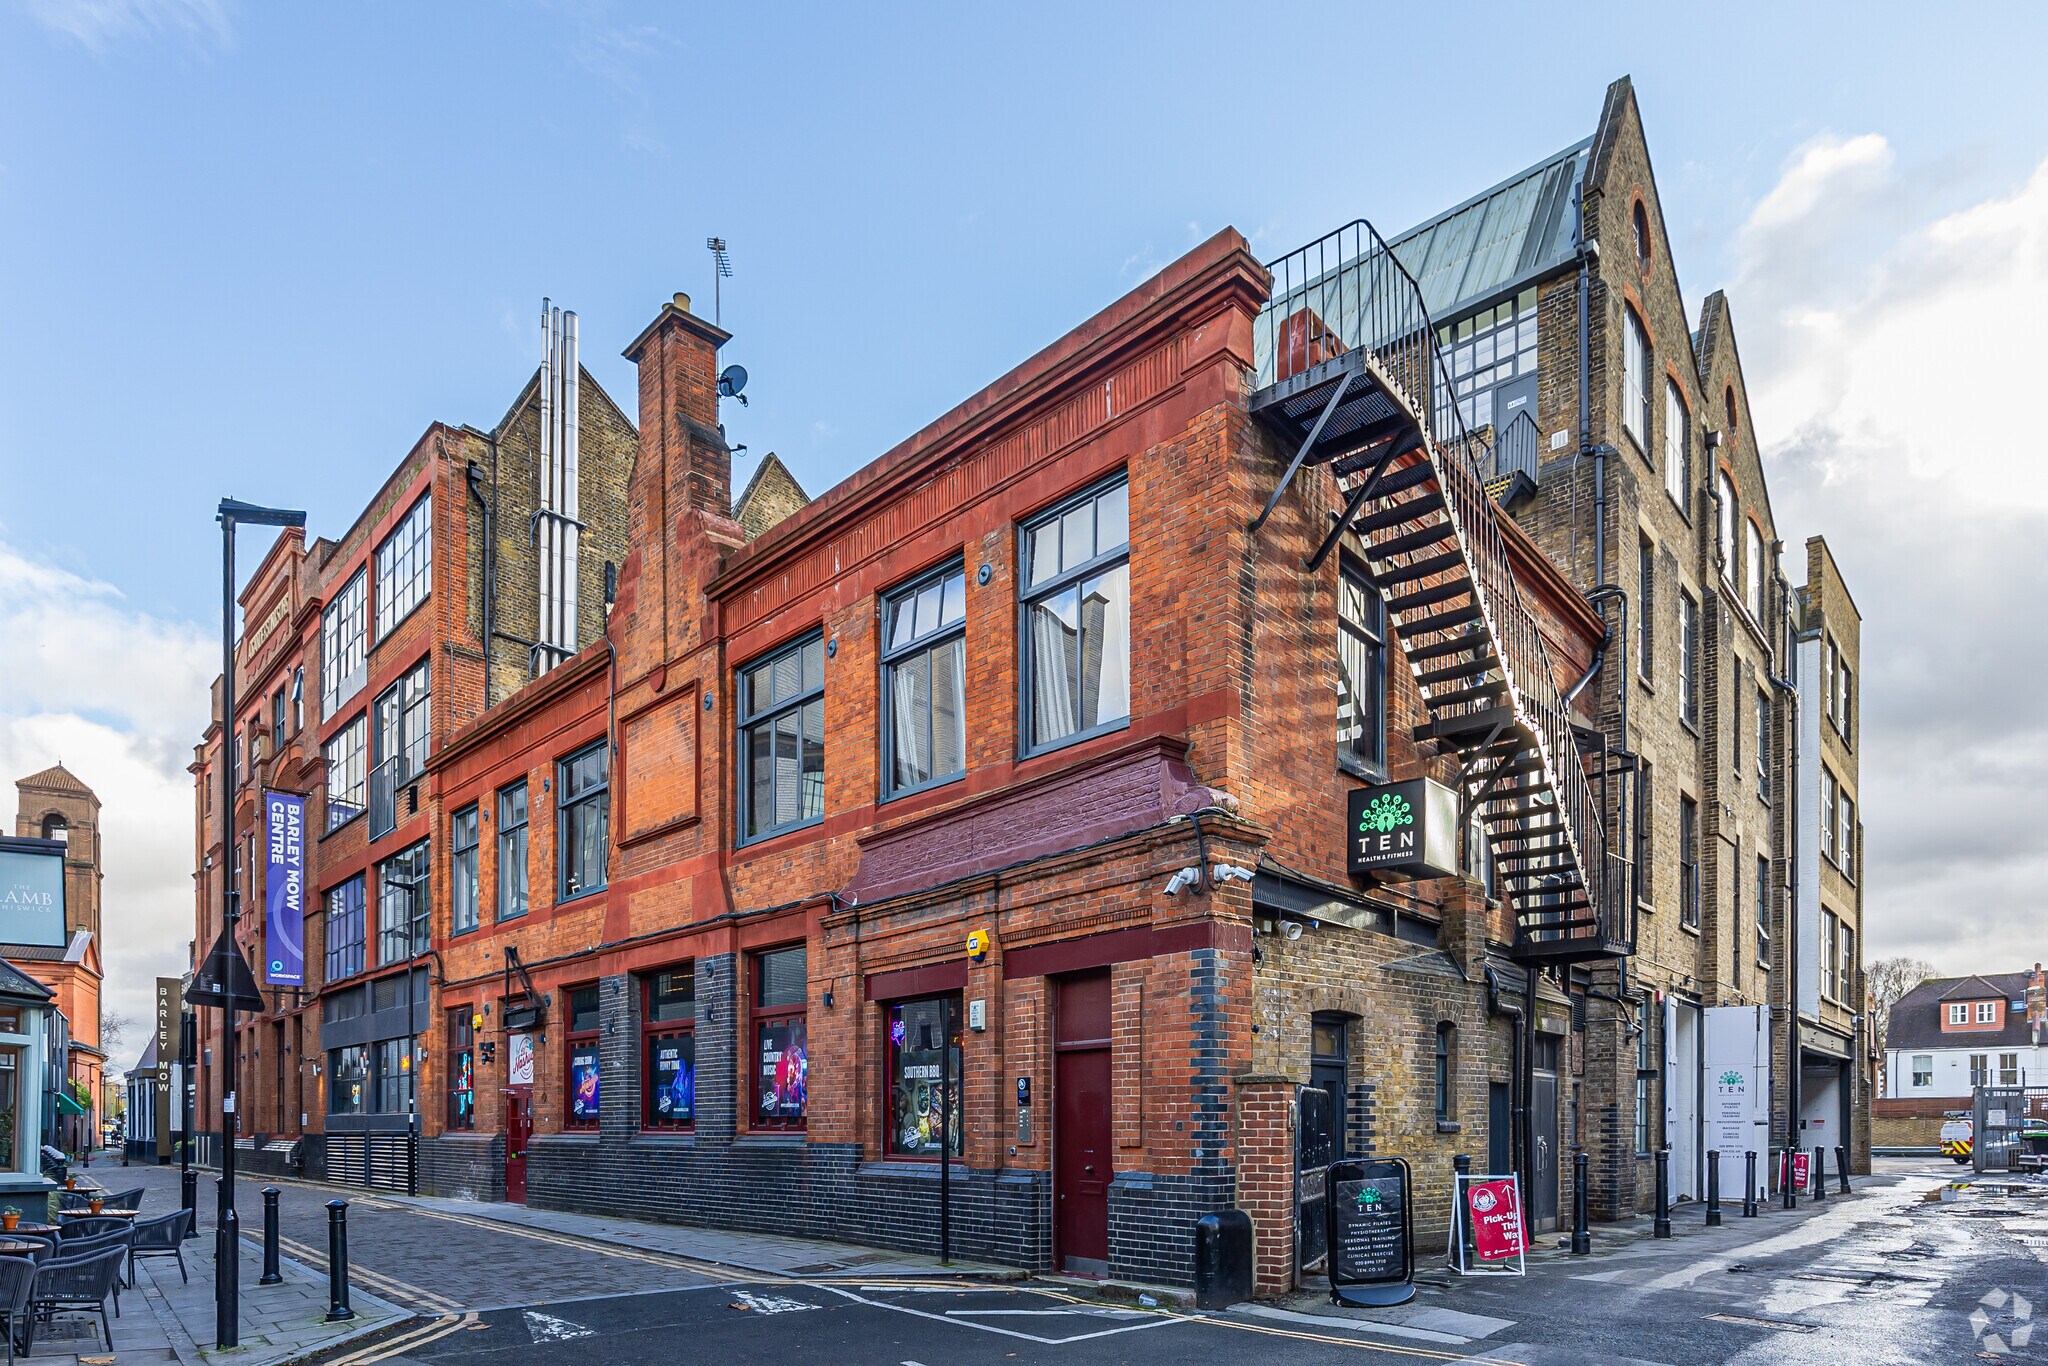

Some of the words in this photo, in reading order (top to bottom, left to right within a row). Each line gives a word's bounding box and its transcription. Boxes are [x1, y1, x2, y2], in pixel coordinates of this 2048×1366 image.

[271, 802, 284, 864] CENTRE
[287, 804, 300, 866] BARLEY
[1358, 830, 1414, 854] TEN
[1358, 854, 1380, 864] HEALTH
[1387, 850, 1414, 860] FITNESS
[286, 869, 300, 911] MOW
[0, 890, 52, 906] AMB
[0, 904, 52, 912] HISWICK
[160, 987, 168, 1050] BARLEY
[763, 1039, 773, 1050] LIVE
[763, 1051, 782, 1062] COUNTRY
[158, 1061, 169, 1092] MOW
[763, 1064, 776, 1076] MUSIC
[904, 1065, 929, 1078] SOUTHERN
[929, 1064, 940, 1077] BBQ
[1358, 1204, 1382, 1212] TEN
